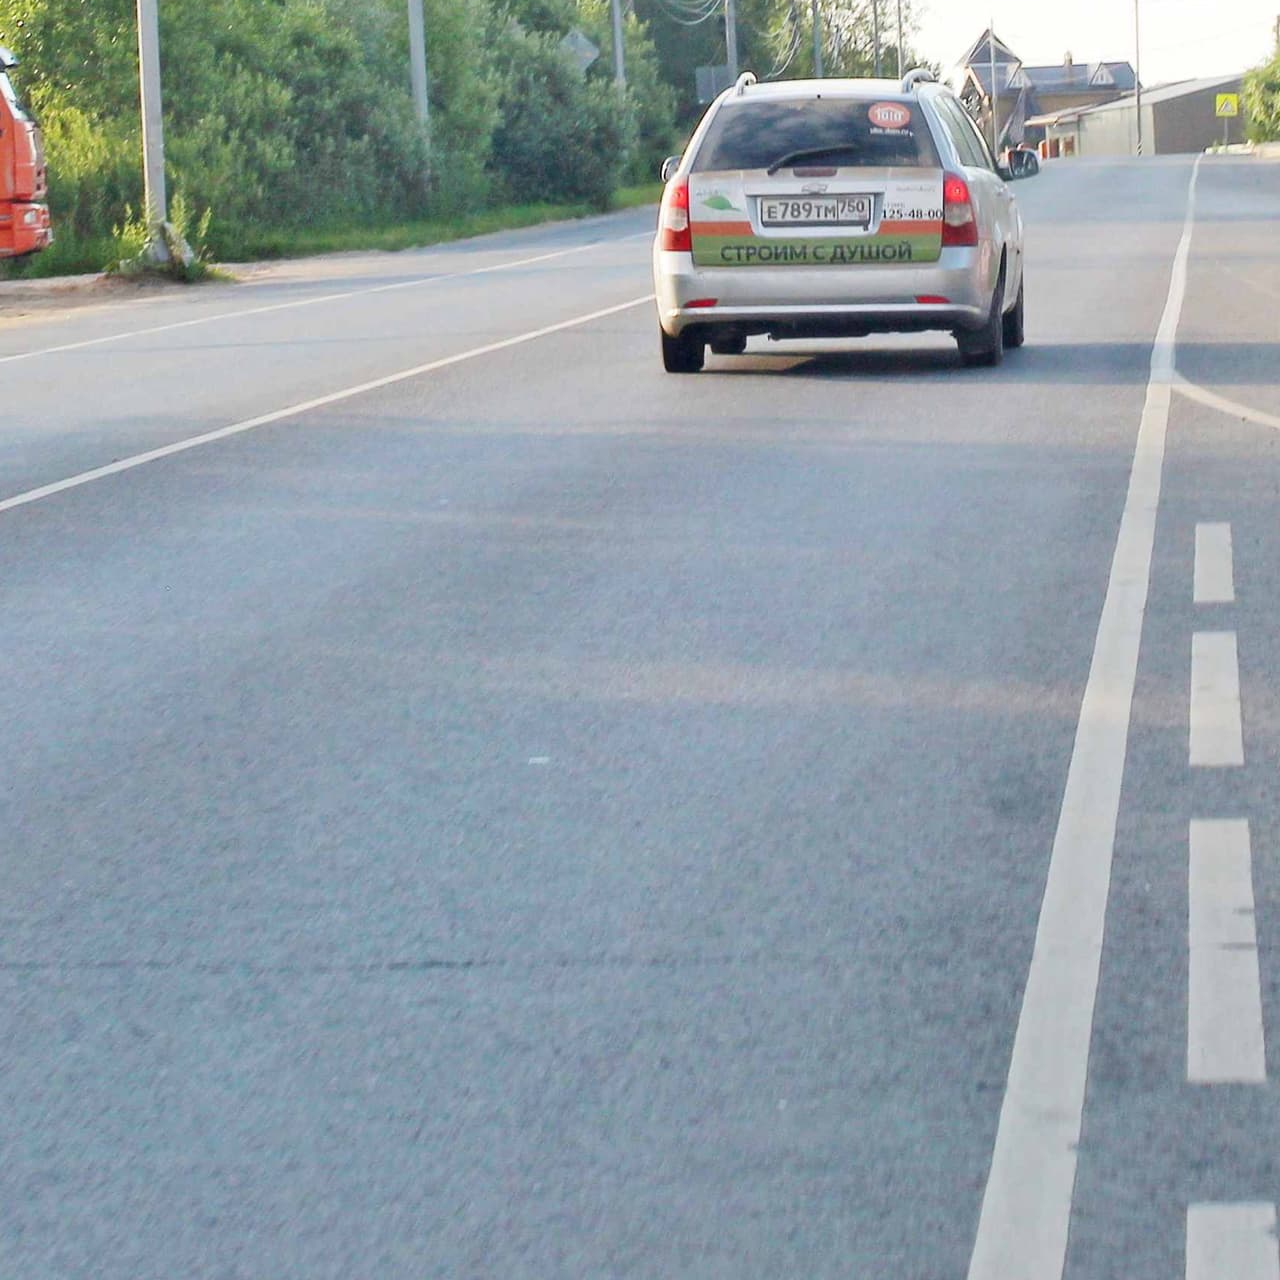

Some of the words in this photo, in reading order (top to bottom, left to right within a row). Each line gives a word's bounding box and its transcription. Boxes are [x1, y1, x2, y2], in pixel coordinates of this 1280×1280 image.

[840, 199, 865, 214] 750
[720, 244, 807, 261] СТРОИМ
[813, 245, 825, 260] С
[830, 240, 913, 263] ДУШОЙ
